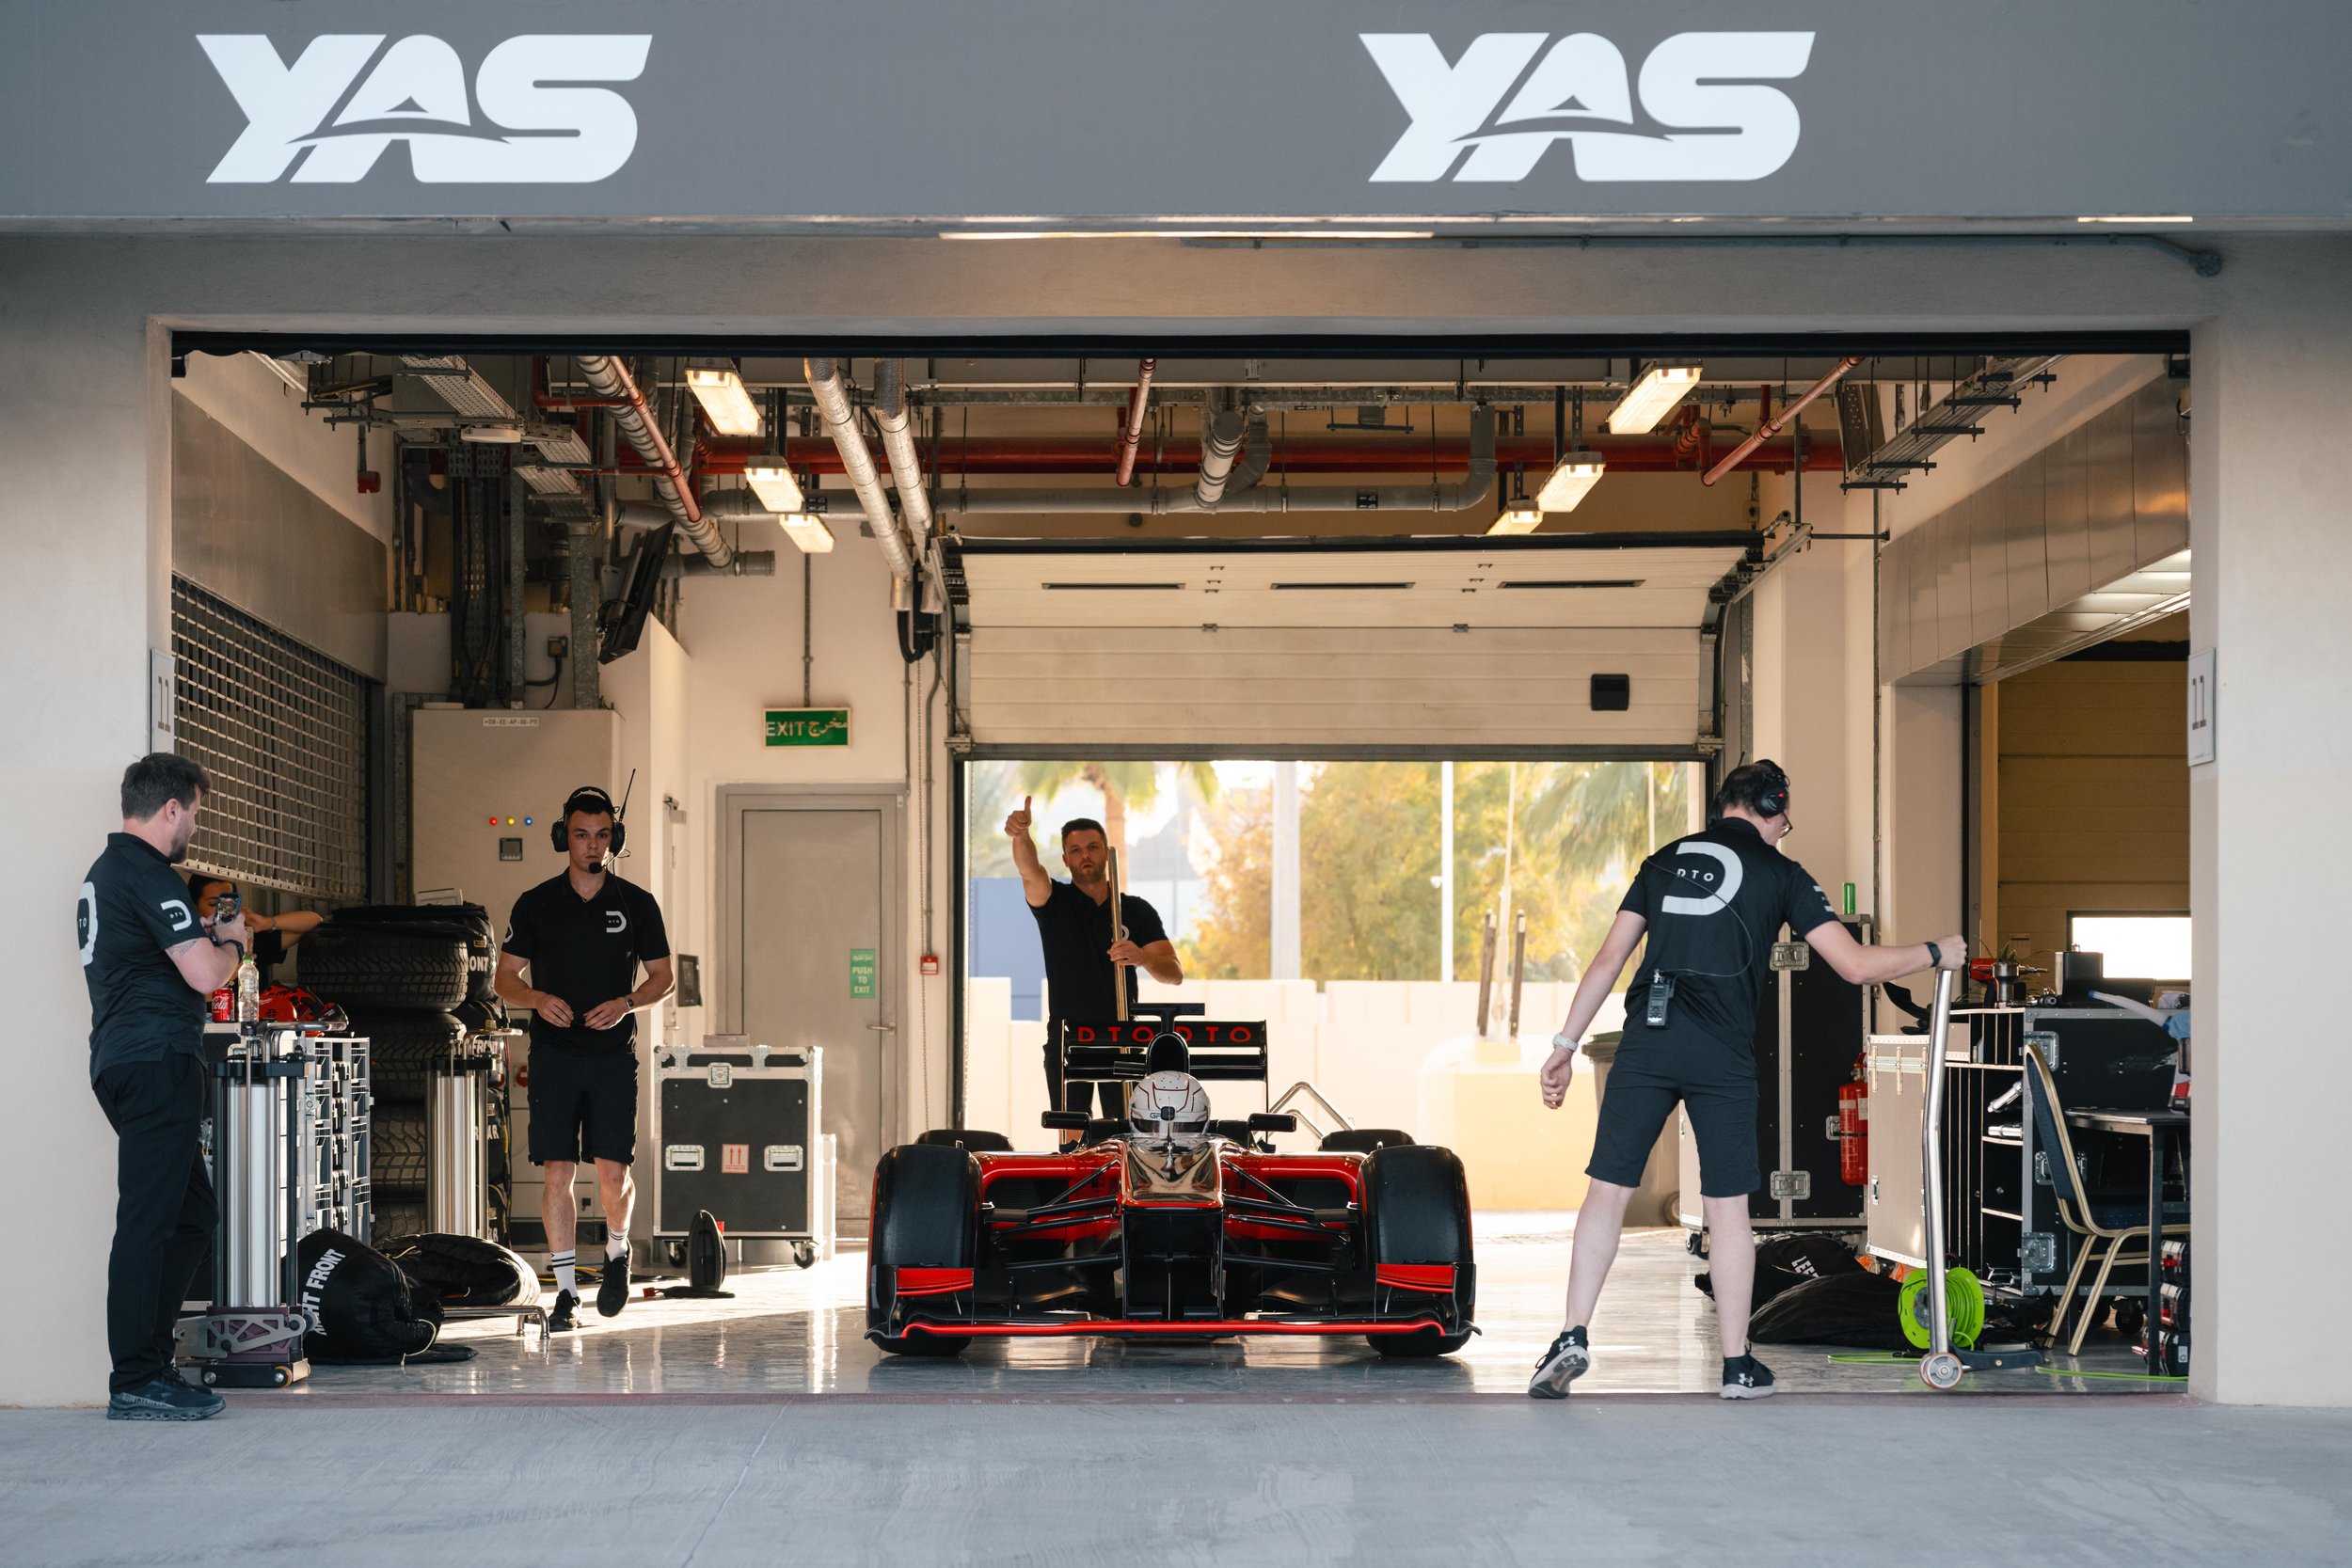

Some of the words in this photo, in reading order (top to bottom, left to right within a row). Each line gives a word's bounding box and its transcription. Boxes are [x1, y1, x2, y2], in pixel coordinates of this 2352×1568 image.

[195, 34, 653, 182] YAS
[1358, 31, 1816, 182] YAS
[158, 675, 170, 733] 11
[2192, 675, 2206, 730] 11
[766, 721, 805, 736] EXIT
[1677, 868, 1714, 882] DTO
[470, 956, 489, 972] ONT
[1077, 1026, 1154, 1042] DTO
[475, 1124, 500, 1140] RAR
[306, 1248, 346, 1290] FRONT
